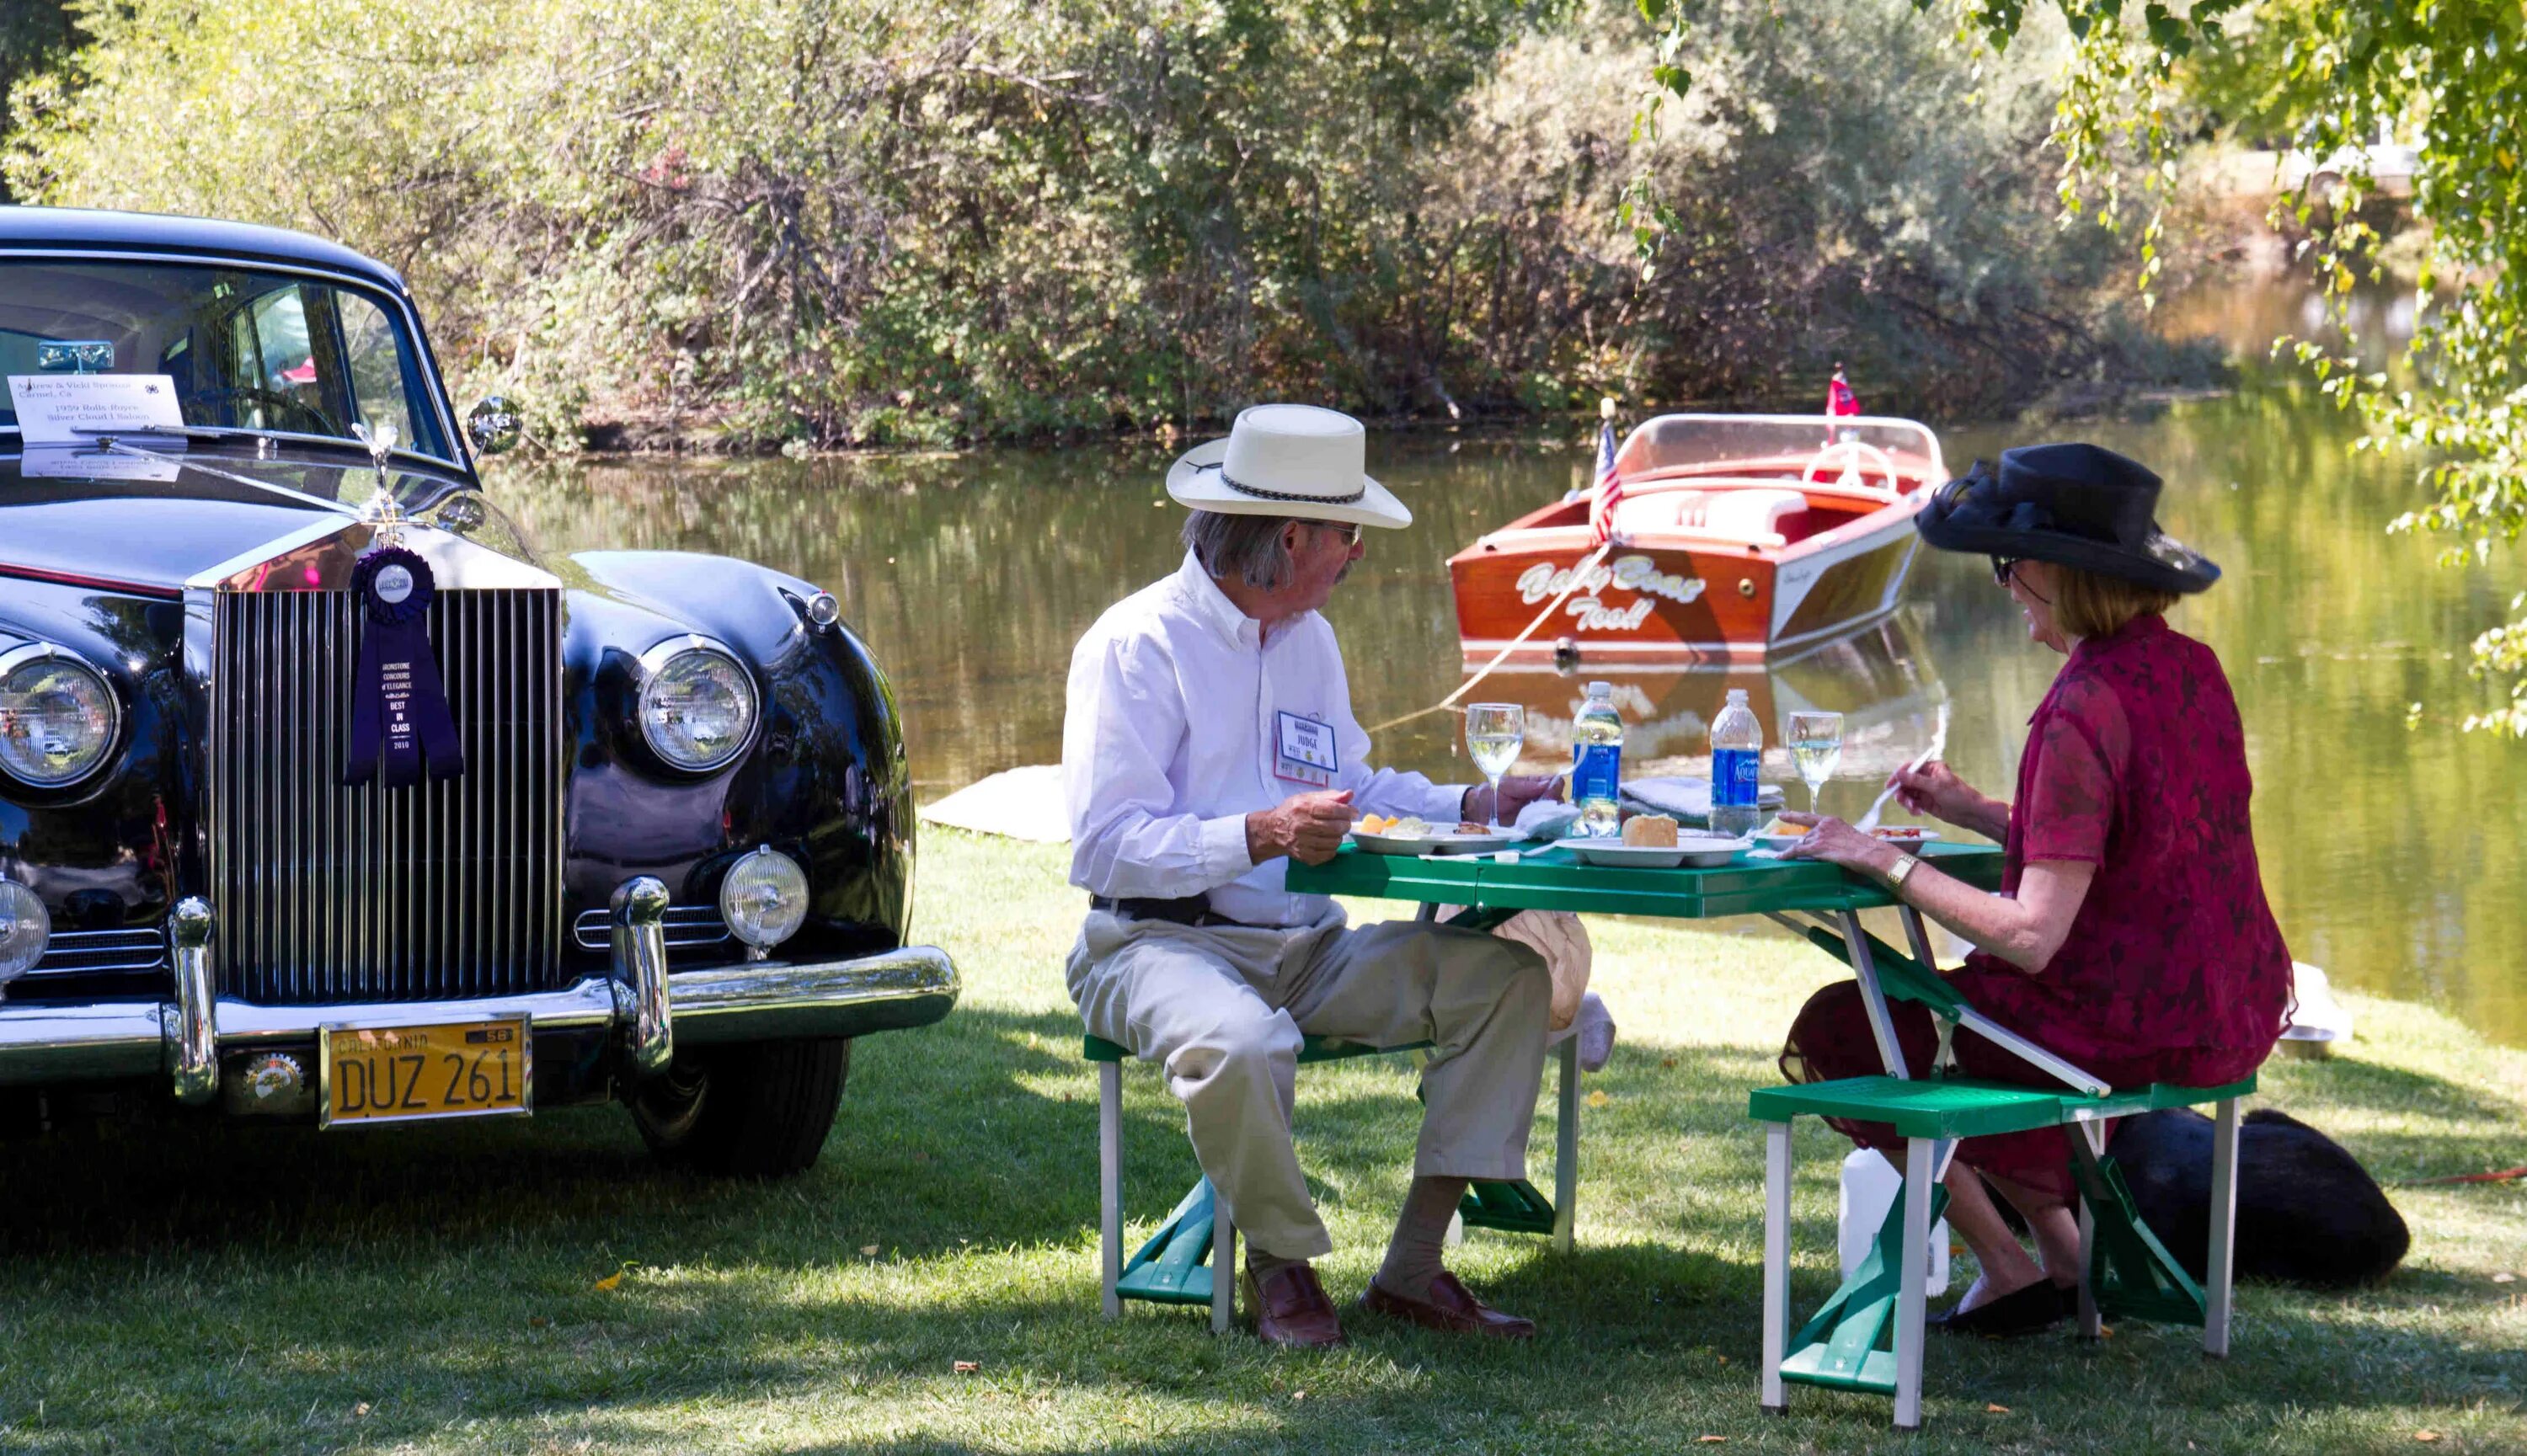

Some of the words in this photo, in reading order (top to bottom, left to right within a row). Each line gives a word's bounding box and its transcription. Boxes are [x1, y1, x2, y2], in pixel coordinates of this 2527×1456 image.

[382, 662, 410, 671] IRONSTONE
[382, 672, 410, 680] CONCOURS
[390, 701, 405, 710] BEST
[396, 712, 403, 721] IN
[391, 723, 410, 733] CLASS
[393, 741, 409, 749] 2010
[338, 1054, 427, 1112] DUZ
[443, 1047, 516, 1105] 261
